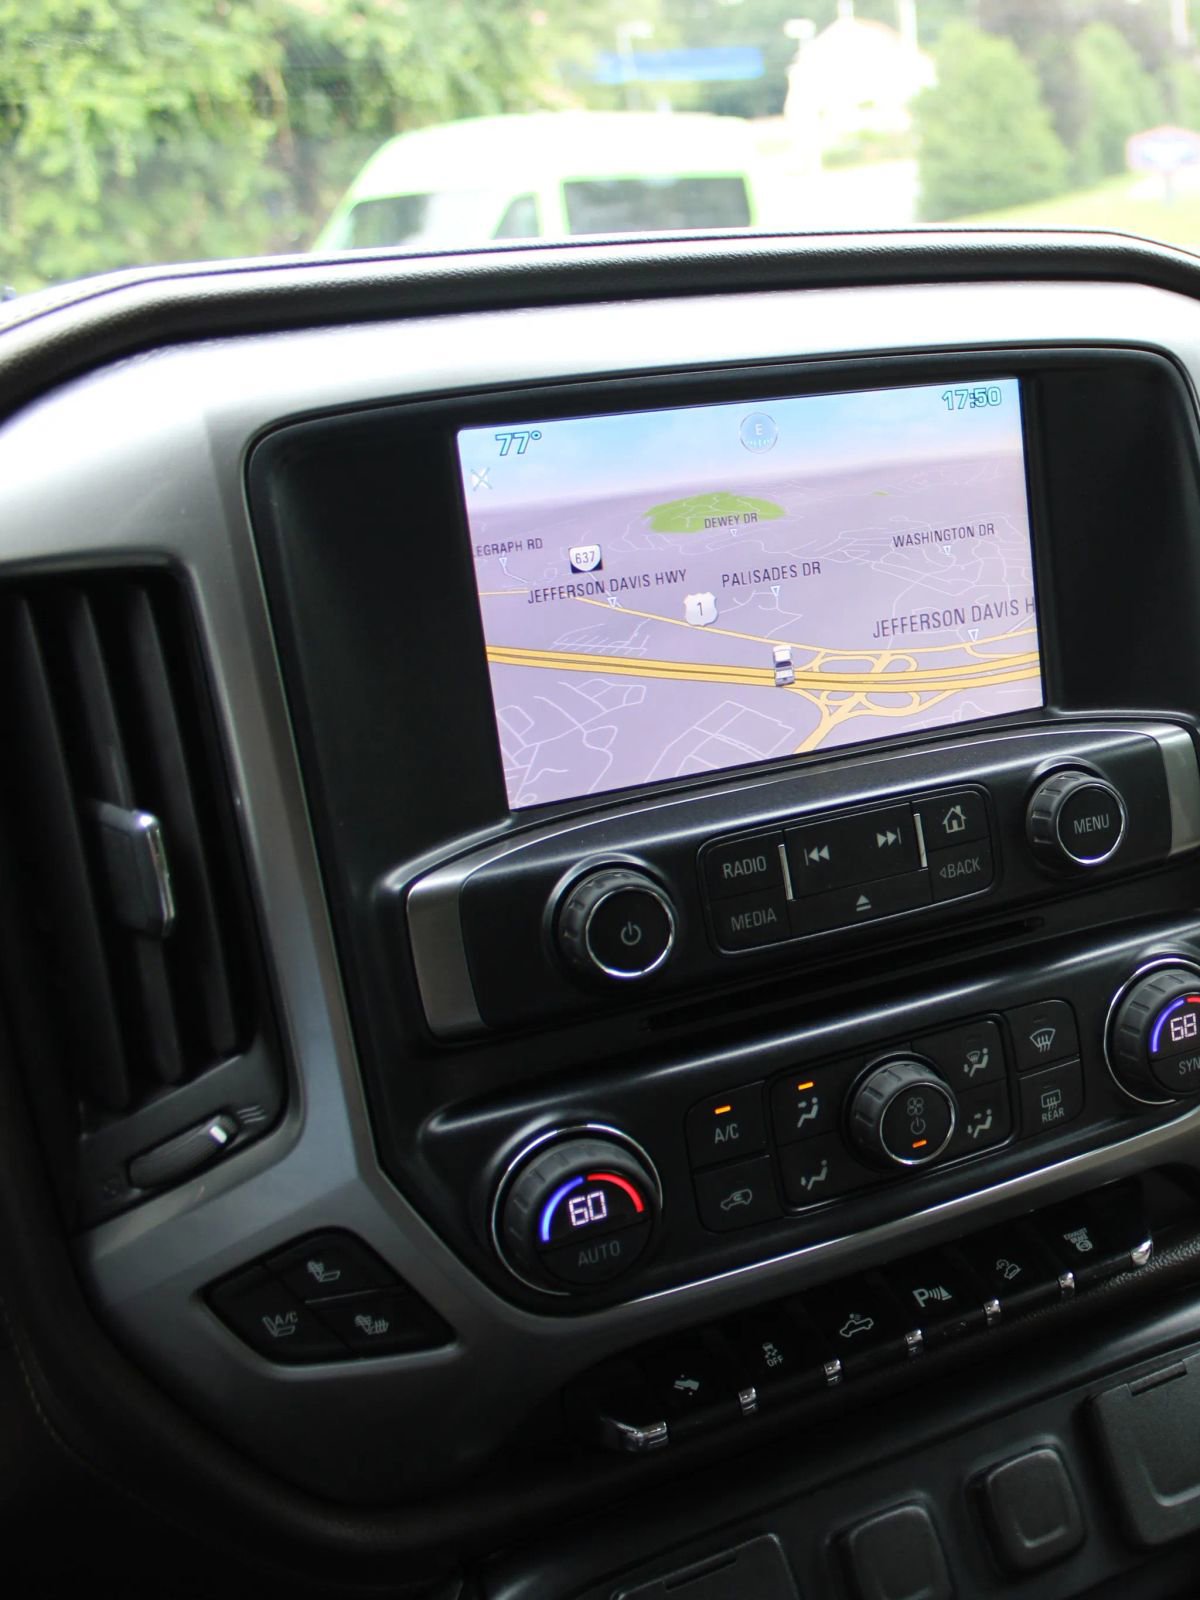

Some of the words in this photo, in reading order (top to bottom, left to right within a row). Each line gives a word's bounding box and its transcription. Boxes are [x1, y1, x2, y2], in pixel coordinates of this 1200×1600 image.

[942, 387, 1001, 410] 17:50
[755, 423, 763, 436] E
[495, 430, 542, 456] 77°
[704, 516, 740, 529] DEWEY
[743, 512, 758, 523] DR
[527, 538, 543, 550] RD
[893, 526, 974, 548] WASHINGTON
[979, 523, 994, 536] DR
[575, 551, 595, 565] 637
[722, 564, 798, 588] PALISADES
[803, 561, 821, 577] DR
[528, 581, 605, 604] JEFFERSON
[610, 574, 651, 592] DAVIS
[655, 569, 687, 585] HWY
[873, 607, 966, 639] JEFFERSON
[971, 600, 1020, 622] DAVIS
[1073, 813, 1111, 835] MENU
[722, 855, 767, 880] RADIO
[948, 857, 982, 879] BACK
[730, 908, 777, 932] MEDIA
[1170, 1013, 1197, 1041] 68
[1041, 1106, 1065, 1123] REAR
[714, 1123, 740, 1144] A/C
[568, 1190, 608, 1227] 60
[577, 1241, 621, 1267] AUTO
[912, 1287, 929, 1308] P
[275, 1311, 298, 1325] A/C
[766, 1355, 784, 1368] OFF
